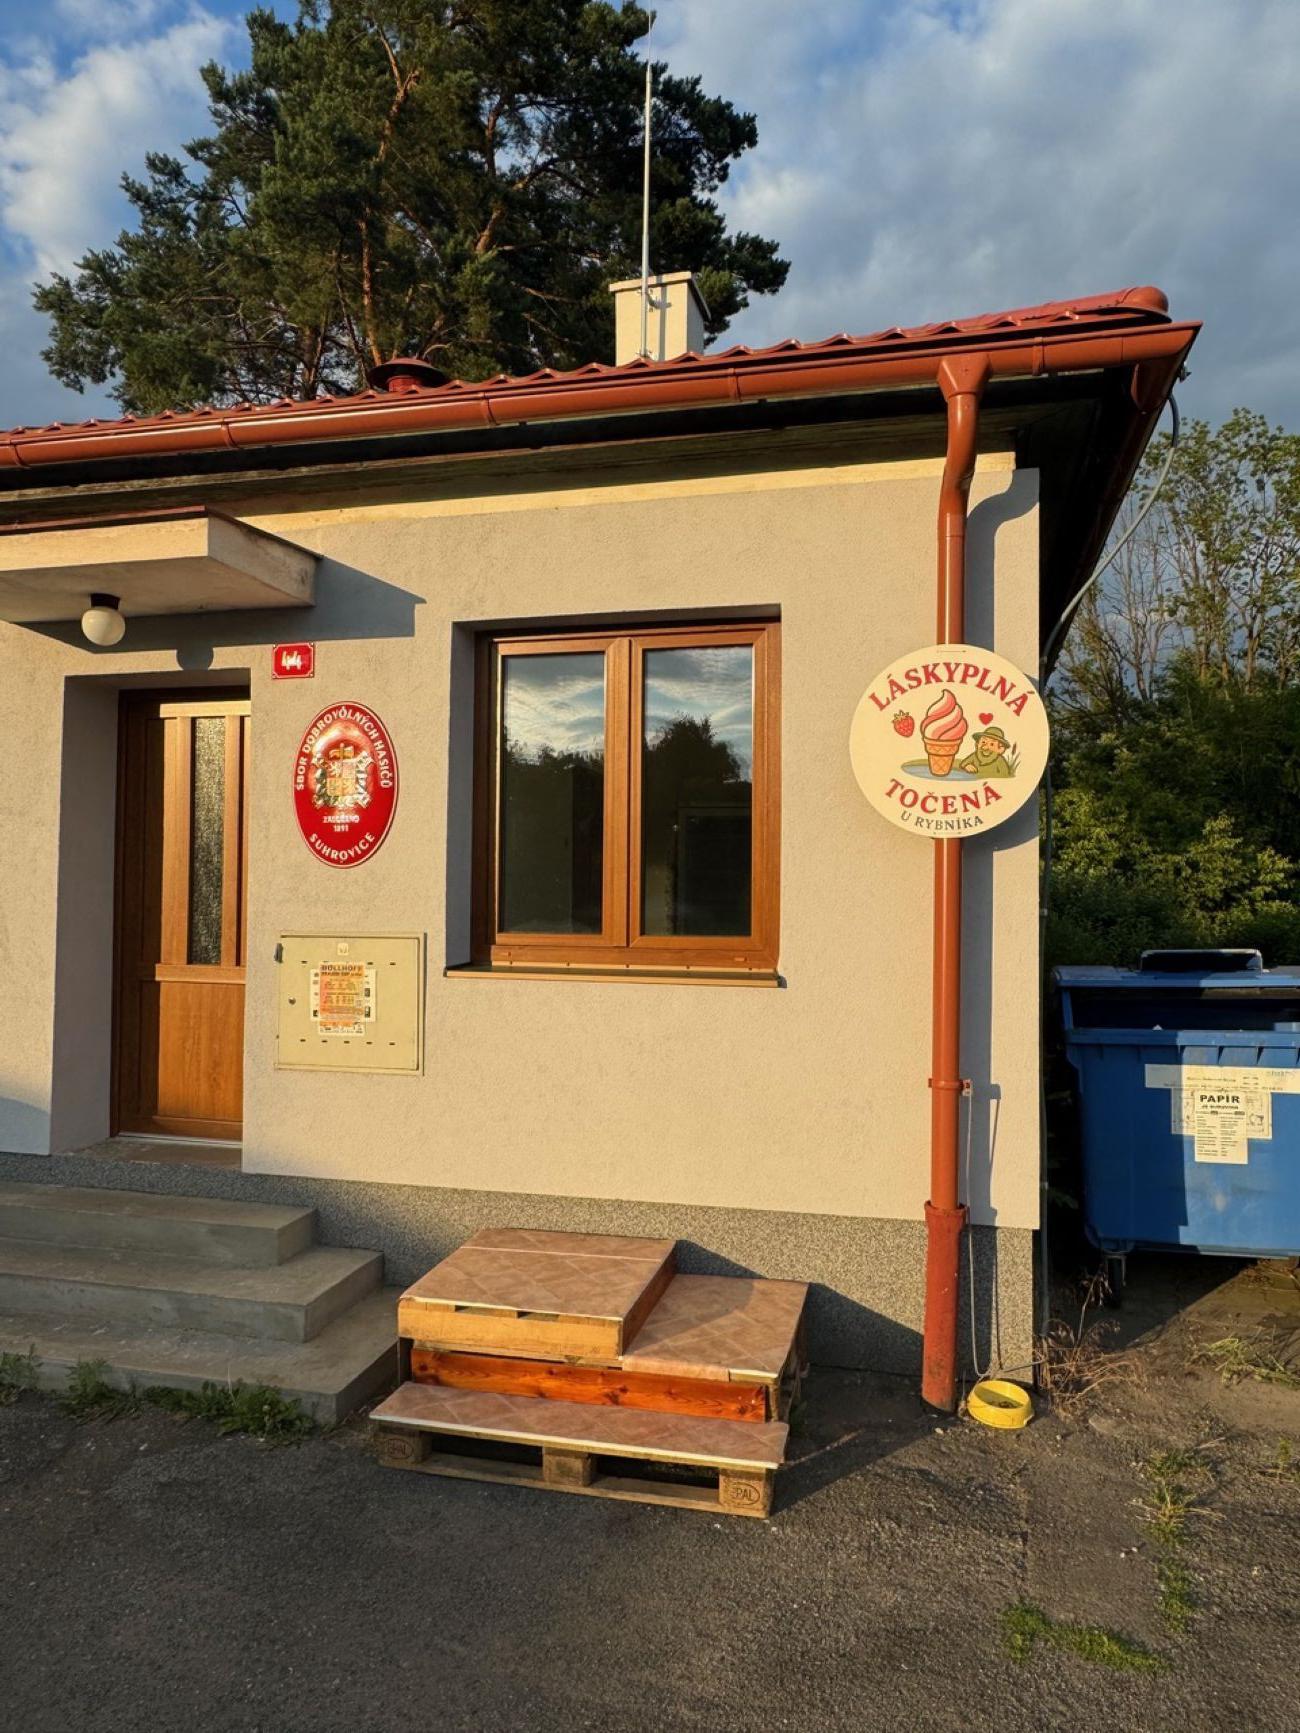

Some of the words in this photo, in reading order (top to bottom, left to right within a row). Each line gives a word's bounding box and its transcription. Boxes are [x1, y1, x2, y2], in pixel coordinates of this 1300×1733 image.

[868, 662, 1036, 717] LÁSKYPLNÁ
[297, 757, 307, 791] SBOR
[373, 740, 393, 789] HASIČŮ
[885, 779, 1003, 815] TOČENÁ
[901, 810, 912, 822] U
[915, 816, 984, 831] RYBNÍKA
[309, 832, 375, 861] SUHROVICE
